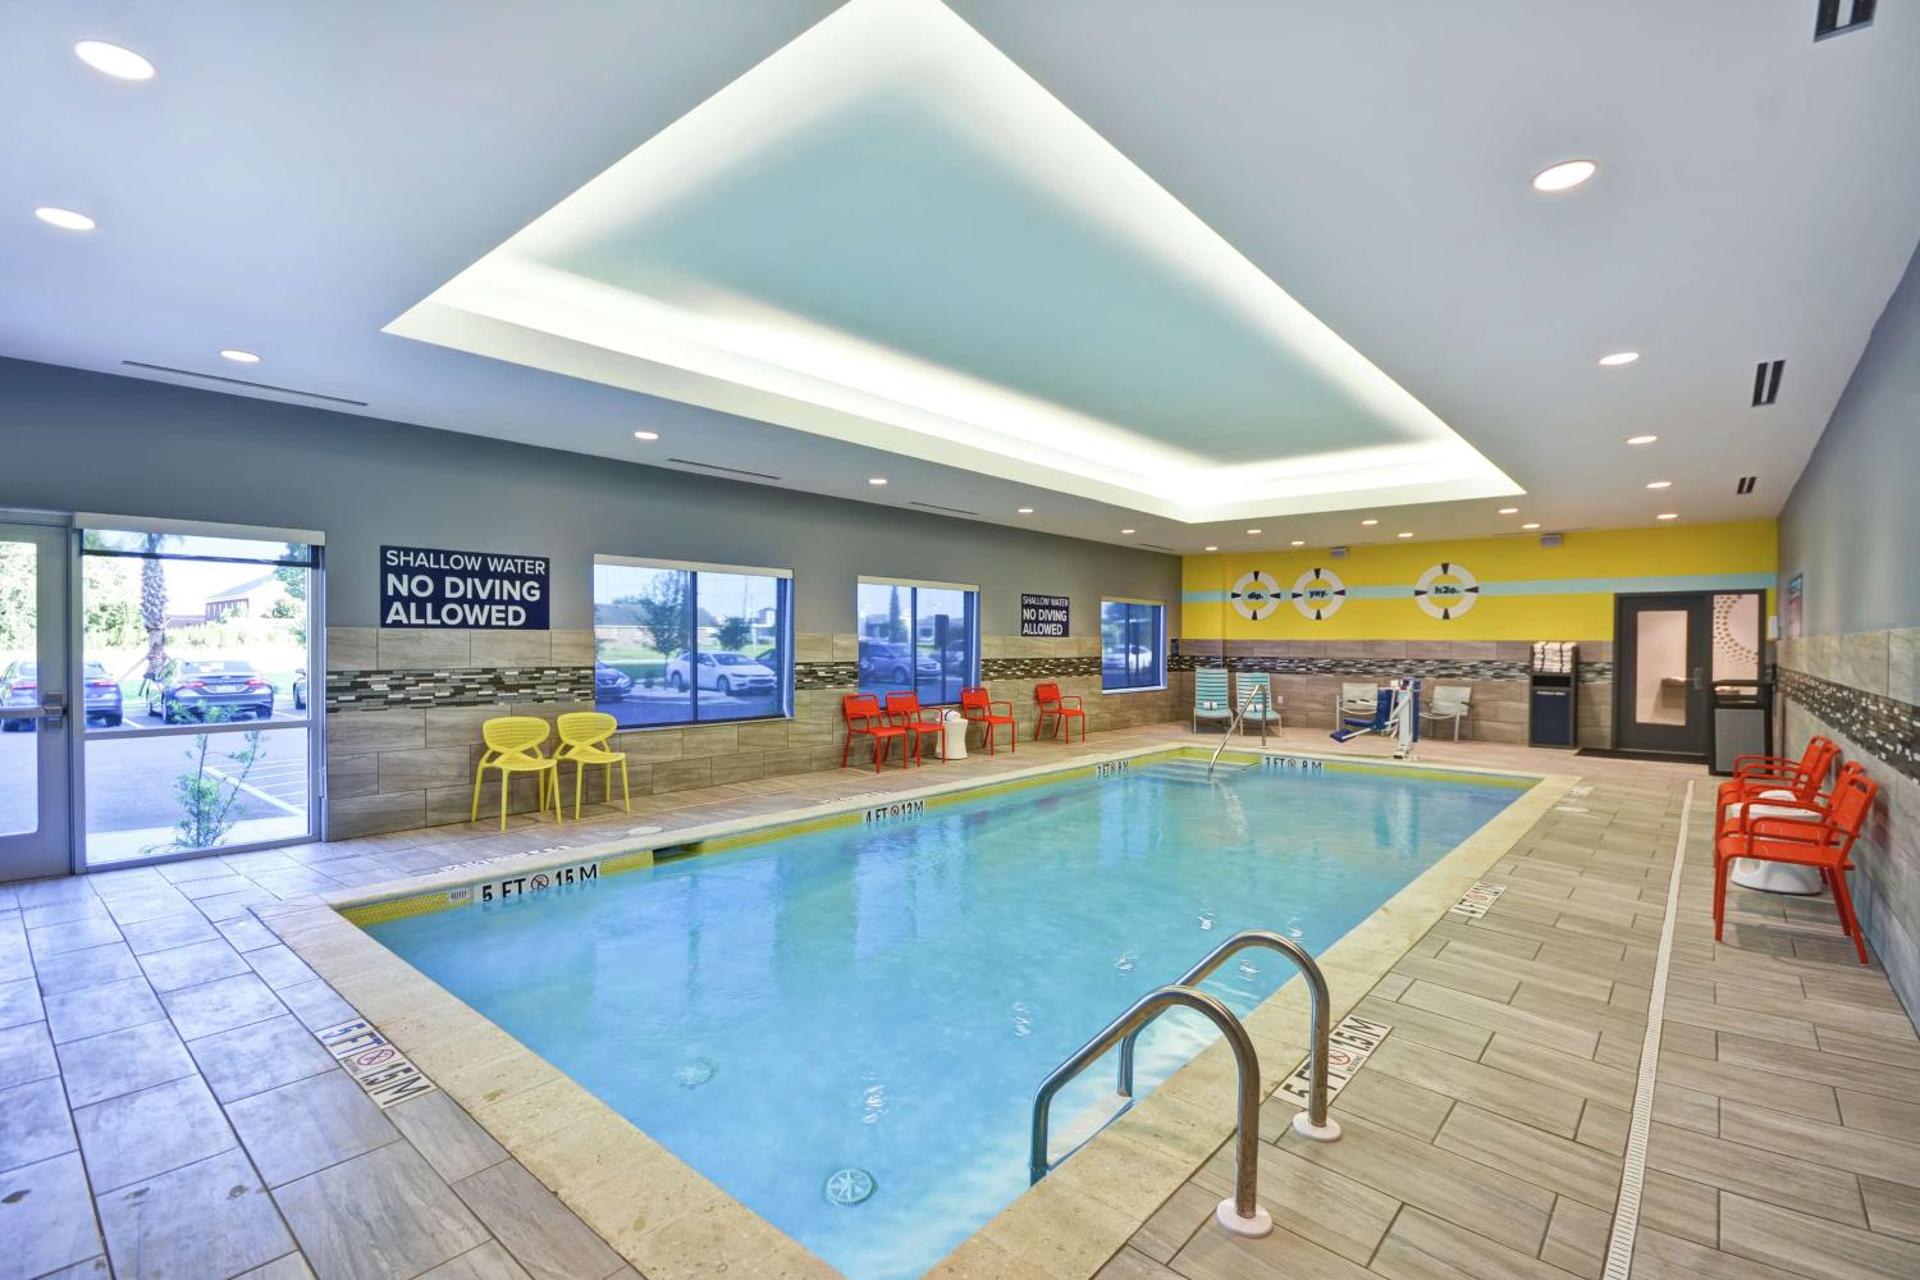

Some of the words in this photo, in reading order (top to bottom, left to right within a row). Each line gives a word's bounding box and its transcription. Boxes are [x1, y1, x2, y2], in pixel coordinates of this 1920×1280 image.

[386, 549, 482, 571] SHALLOW
[487, 556, 546, 576] WATER
[387, 573, 434, 598] NO
[445, 576, 541, 602] DIVING
[1434, 585, 1460, 595] h2o.
[1022, 595, 1050, 606] SHALLOW
[1050, 598, 1068, 607] WATER
[385, 601, 526, 627] ALLOWED
[1023, 608, 1037, 620] NO
[1038, 608, 1067, 622] DIVING
[1022, 622, 1063, 636] ALLOWED
[876, 807, 888, 821] FT
[914, 801, 924, 814] M
[482, 884, 493, 902] 5
[502, 878, 526, 898] FT
[580, 864, 598, 882] M
[1341, 1016, 1388, 1038] M
[374, 1076, 431, 1105] M
